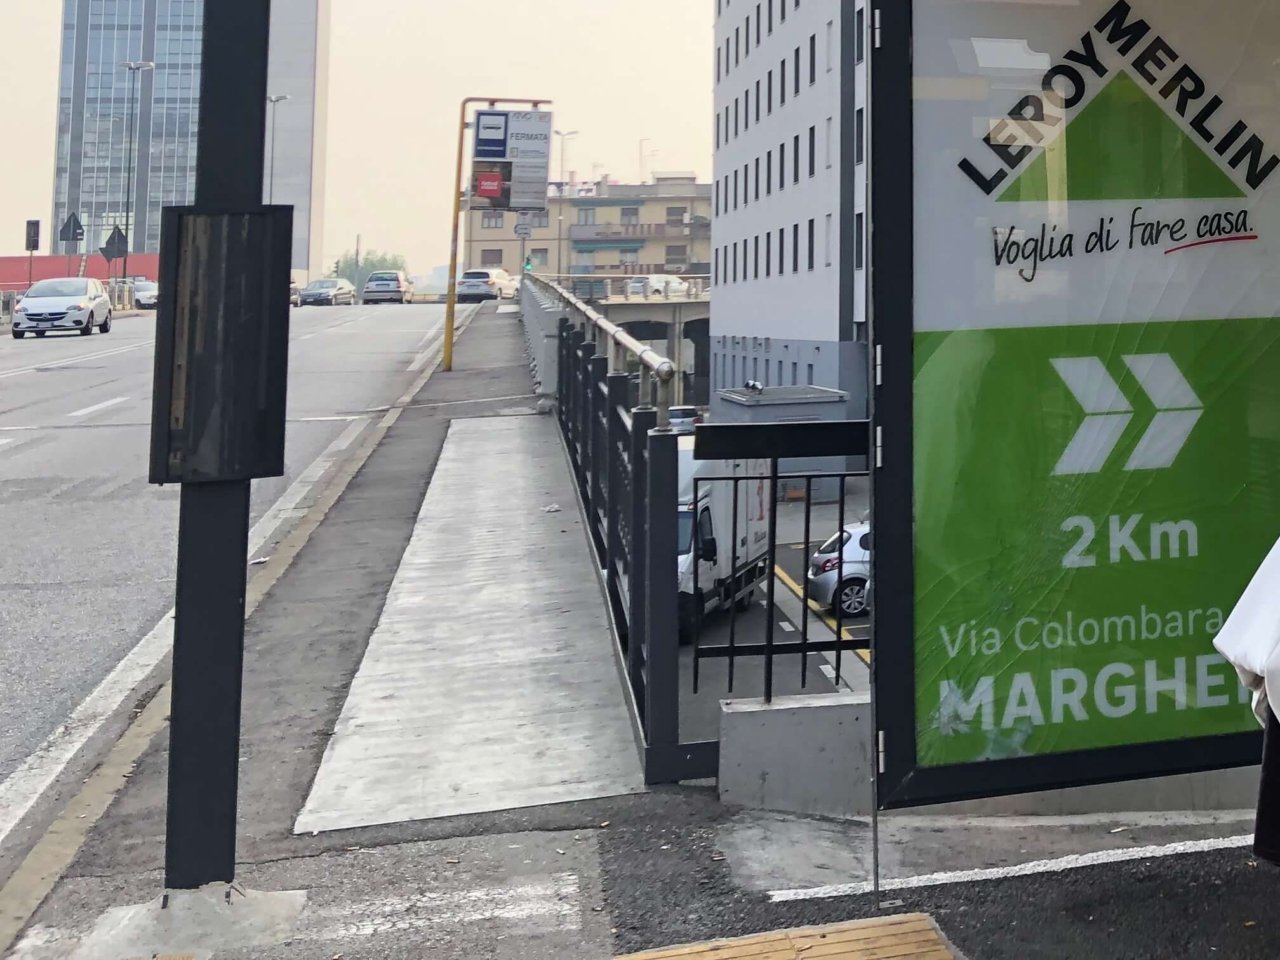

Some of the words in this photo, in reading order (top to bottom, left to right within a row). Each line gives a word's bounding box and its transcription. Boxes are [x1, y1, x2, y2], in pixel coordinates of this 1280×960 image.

[509, 132, 548, 141] FERMATA
[957, 30, 1109, 196] LEROY
[992, 224, 1074, 283] Voglia
[1085, 216, 1119, 254] di
[1059, 515, 1097, 569] 2
[1108, 512, 1199, 564] Km
[938, 619, 1001, 658] Via
[1015, 603, 1223, 652] Colombara
